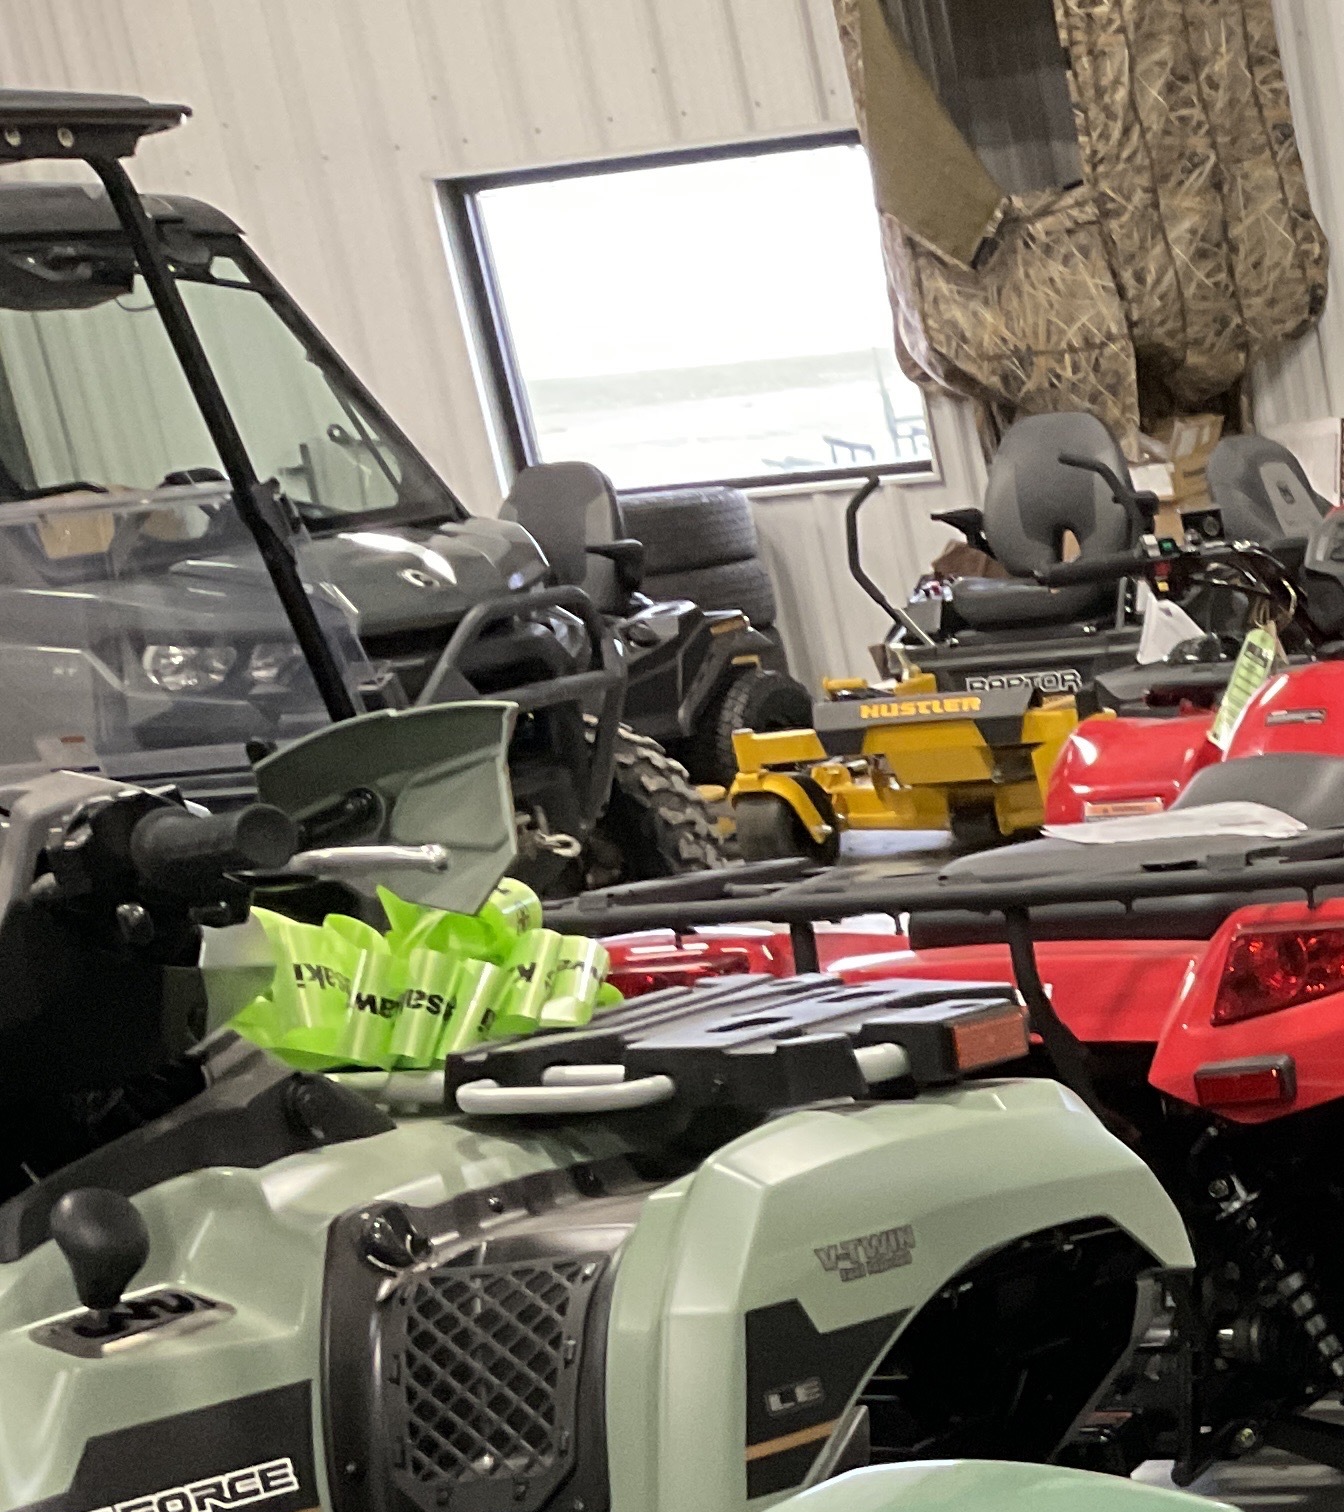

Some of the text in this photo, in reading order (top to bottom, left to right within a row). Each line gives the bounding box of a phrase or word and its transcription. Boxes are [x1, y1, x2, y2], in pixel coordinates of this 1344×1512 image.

[965, 669, 1083, 694] RAPTOR
[860, 696, 981, 719] HUSTLER
[814, 1224, 916, 1272] V-TWIN
[766, 1379, 822, 1413] LE
